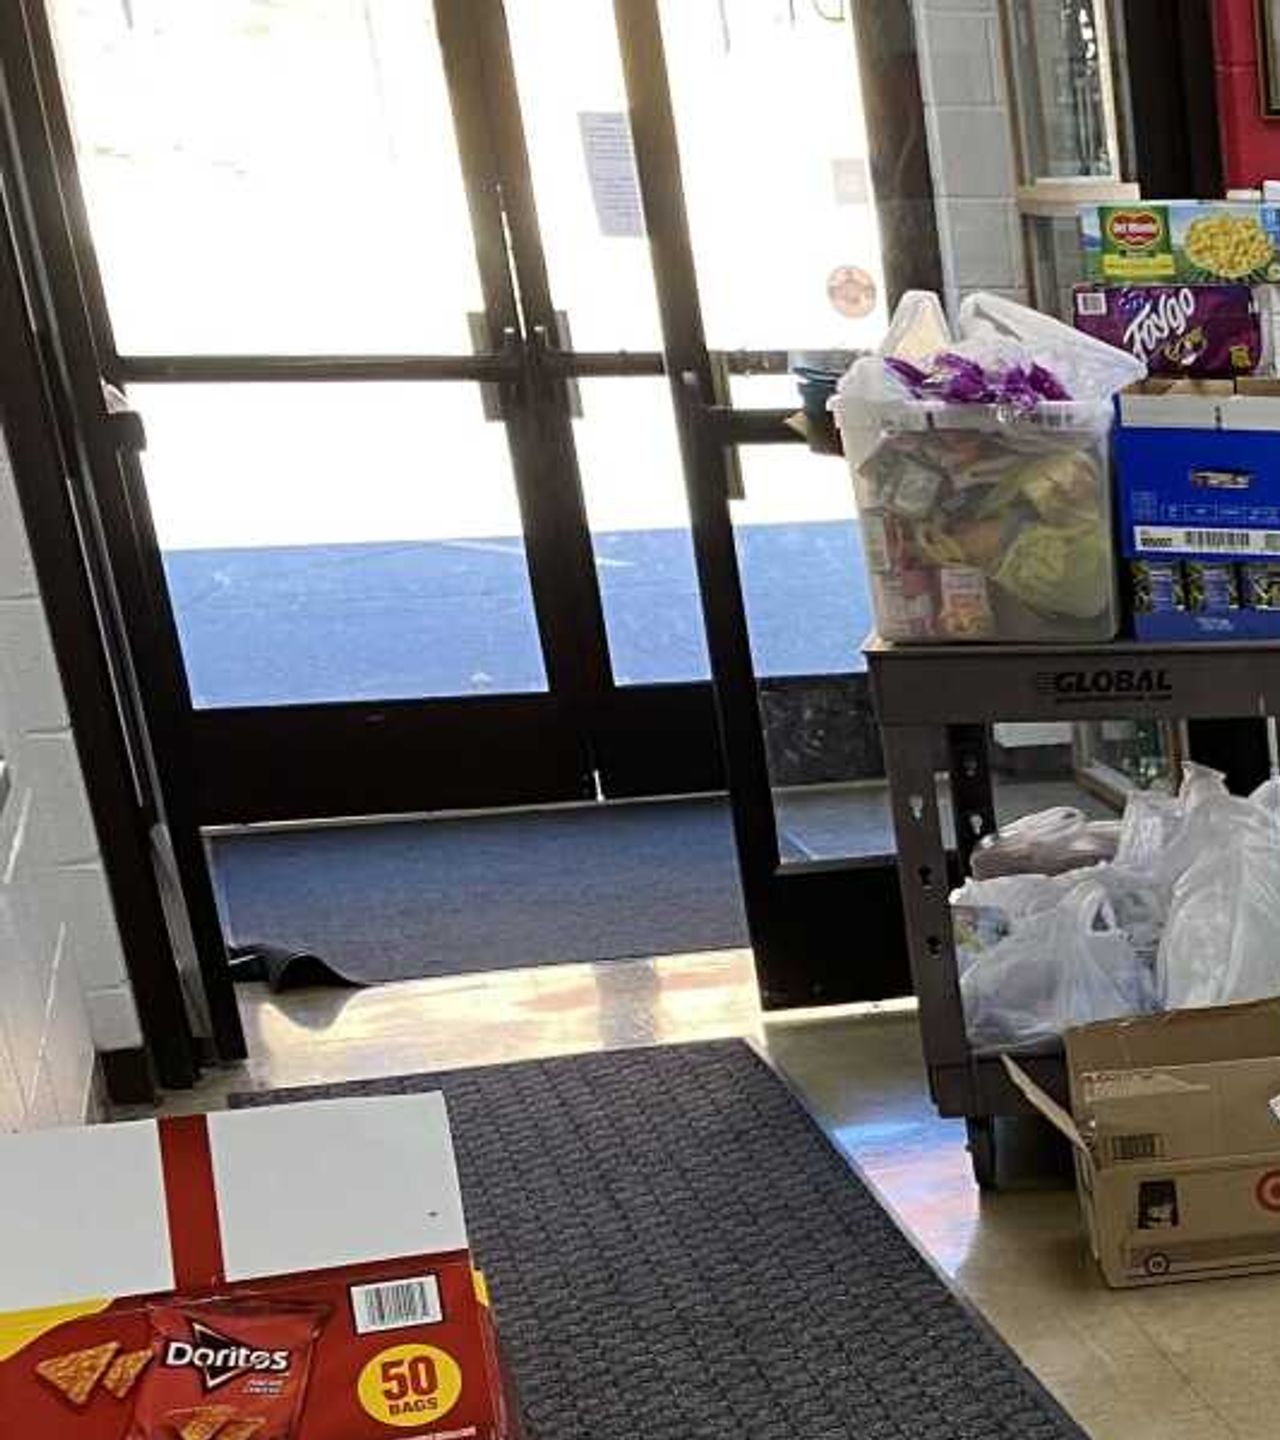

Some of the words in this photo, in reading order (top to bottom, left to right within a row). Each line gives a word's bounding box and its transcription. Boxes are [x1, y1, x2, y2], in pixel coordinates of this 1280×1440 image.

[1123, 287, 1196, 364] Faygo
[1055, 669, 1174, 693] GLOBAL
[165, 1341, 290, 1372] Doritos
[381, 1354, 438, 1402] 50
[388, 1397, 439, 1416] BAGS
